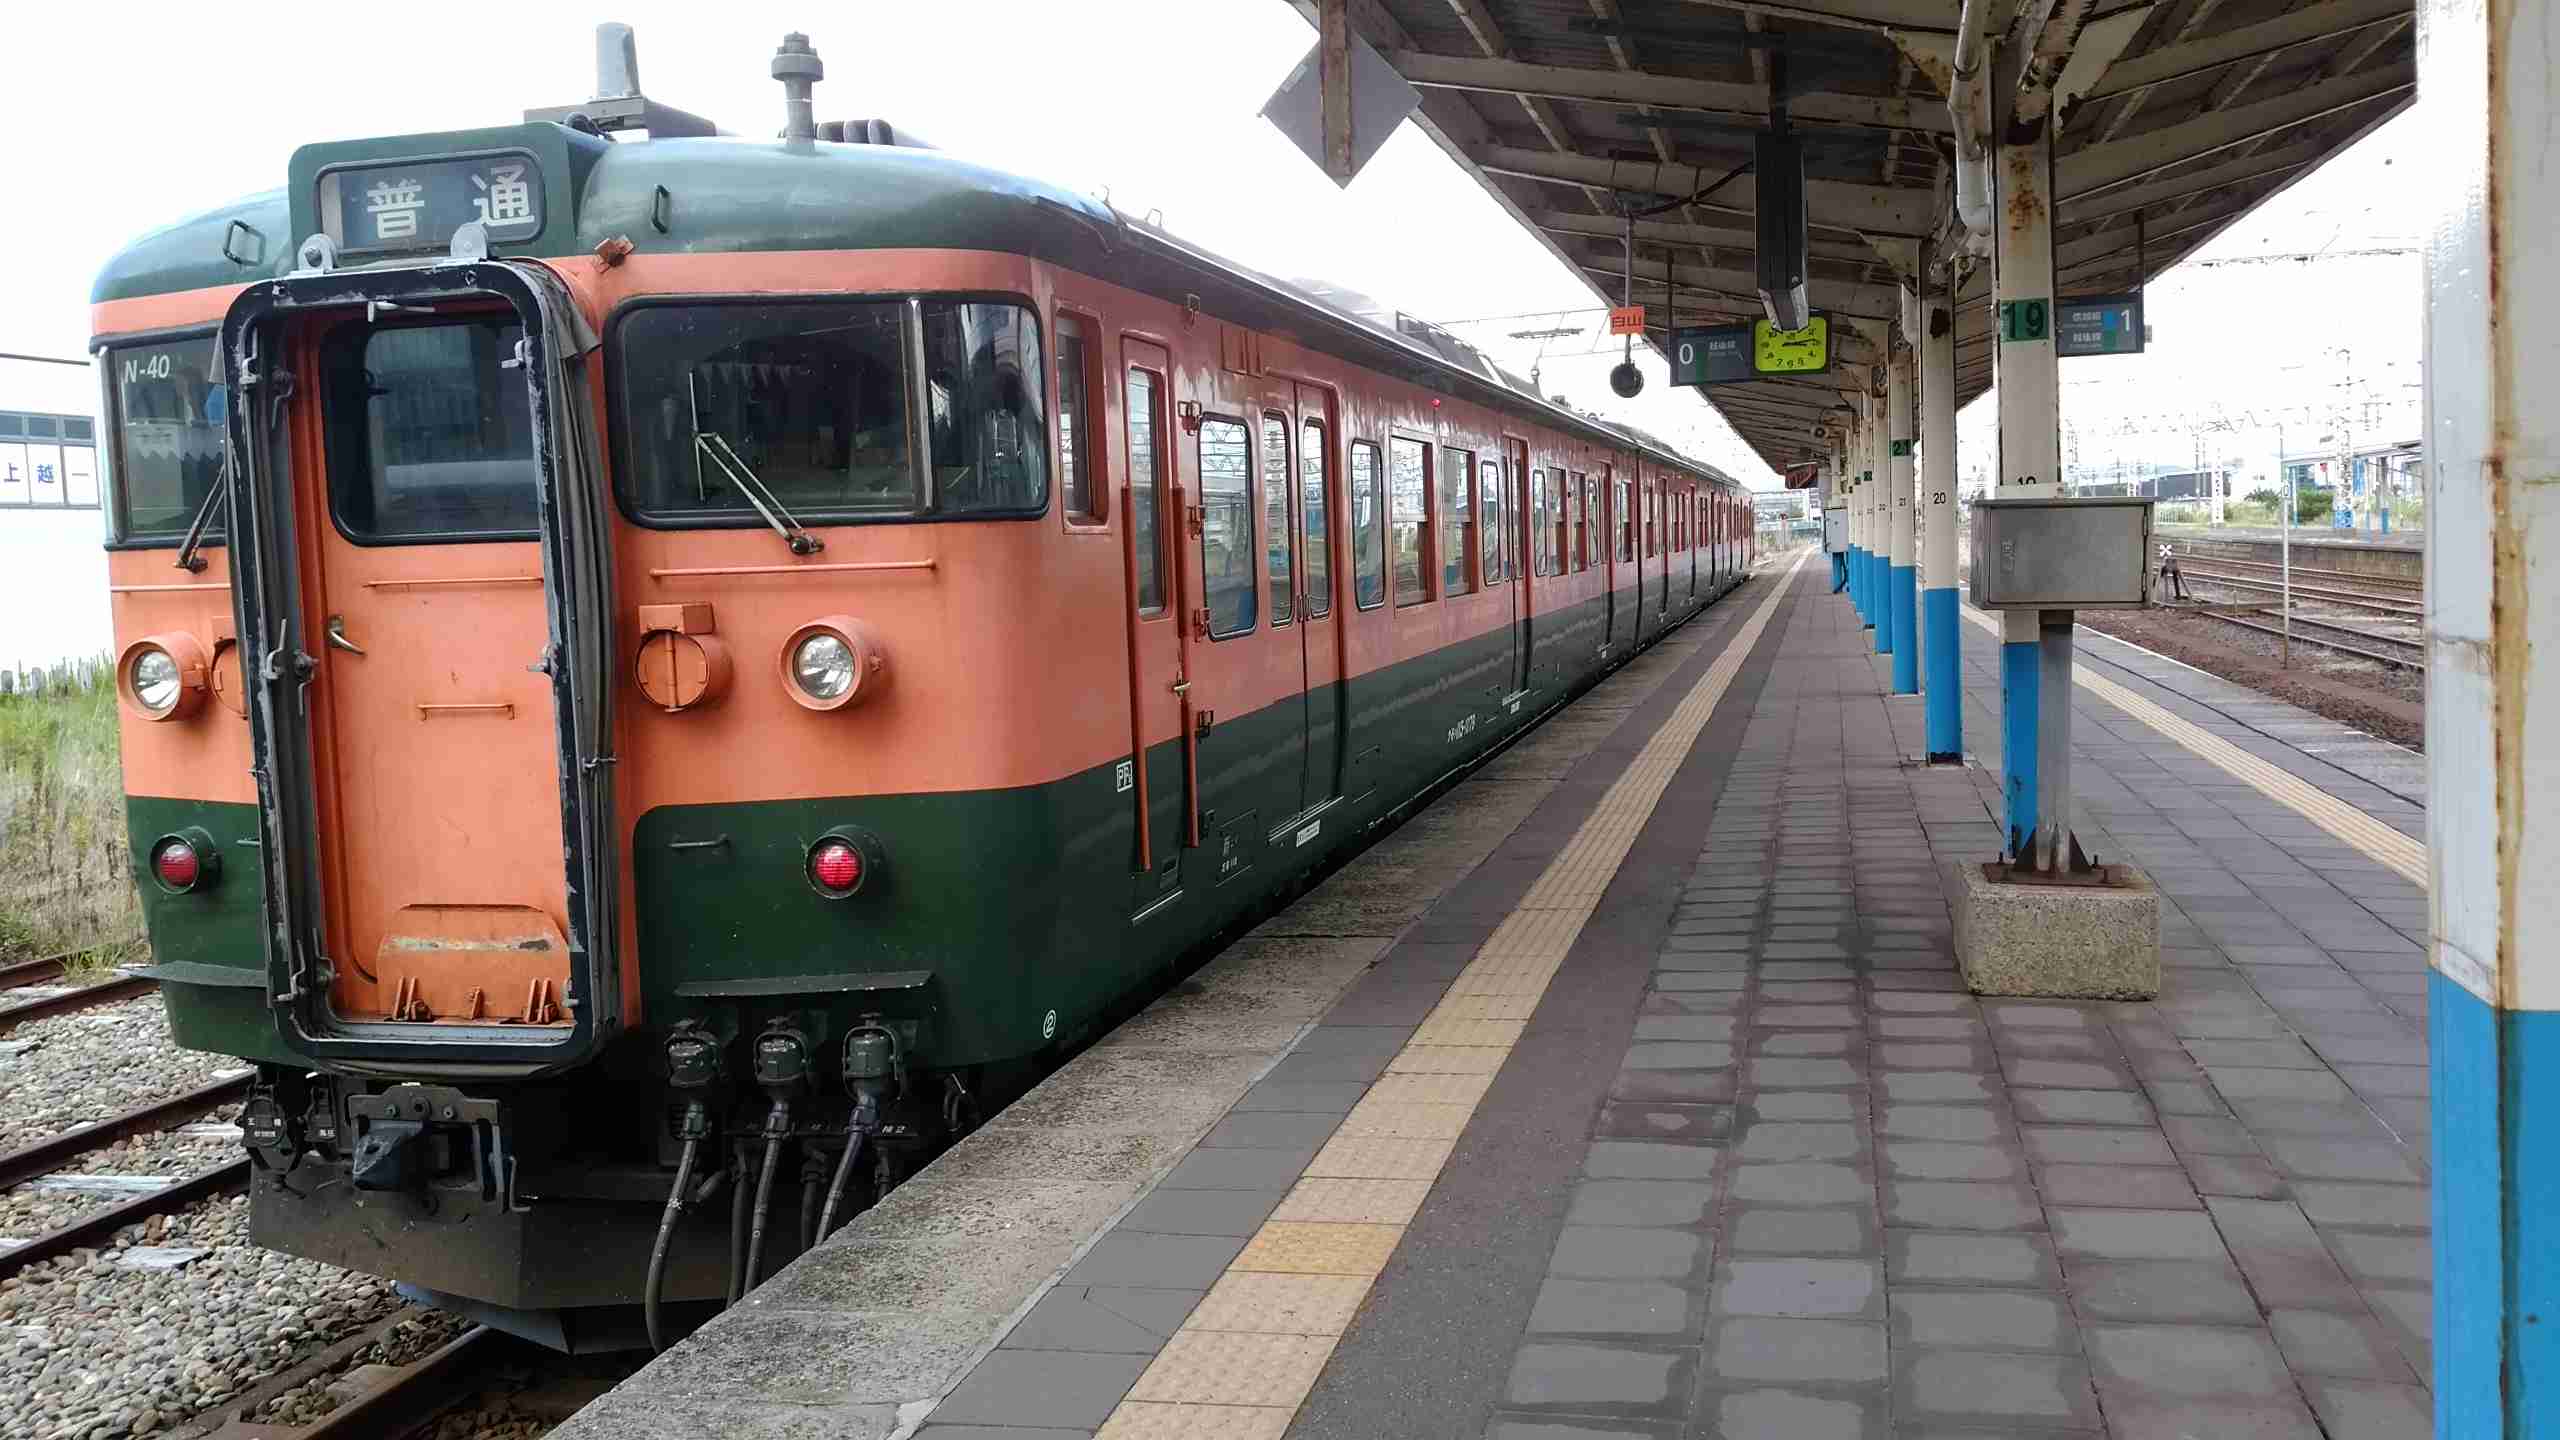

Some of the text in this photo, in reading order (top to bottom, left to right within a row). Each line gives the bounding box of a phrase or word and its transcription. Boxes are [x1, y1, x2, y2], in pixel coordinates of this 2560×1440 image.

[367, 163, 535, 240] 普通
[2001, 302, 2045, 338] 19
[2121, 309, 2130, 332] 1
[1679, 343, 1694, 364] 0
[124, 354, 170, 384] N-40
[1893, 439, 1910, 456] 21
[1932, 491, 1947, 505] 20
